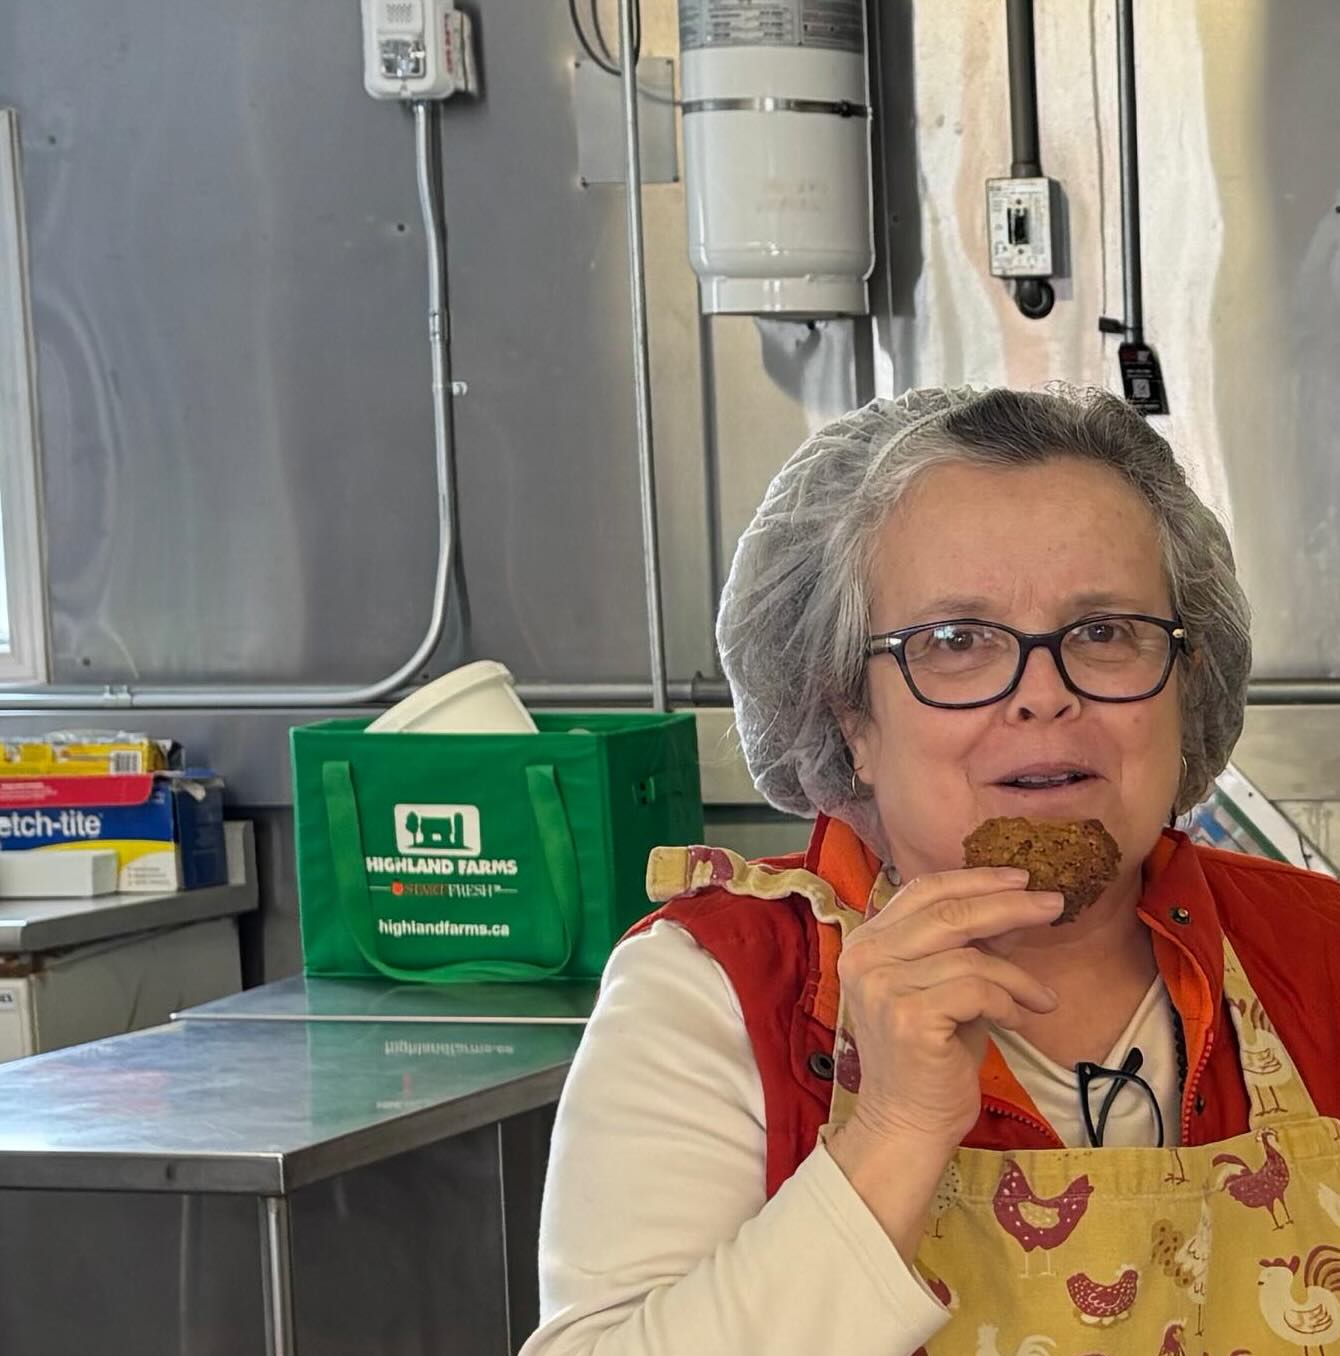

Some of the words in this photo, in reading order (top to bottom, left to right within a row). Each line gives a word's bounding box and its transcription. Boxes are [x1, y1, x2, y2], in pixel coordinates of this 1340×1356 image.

[366, 856, 453, 875] HIGHLAND
[458, 859, 518, 876] FARMS
[379, 919, 510, 938] highlandfarms.ca
